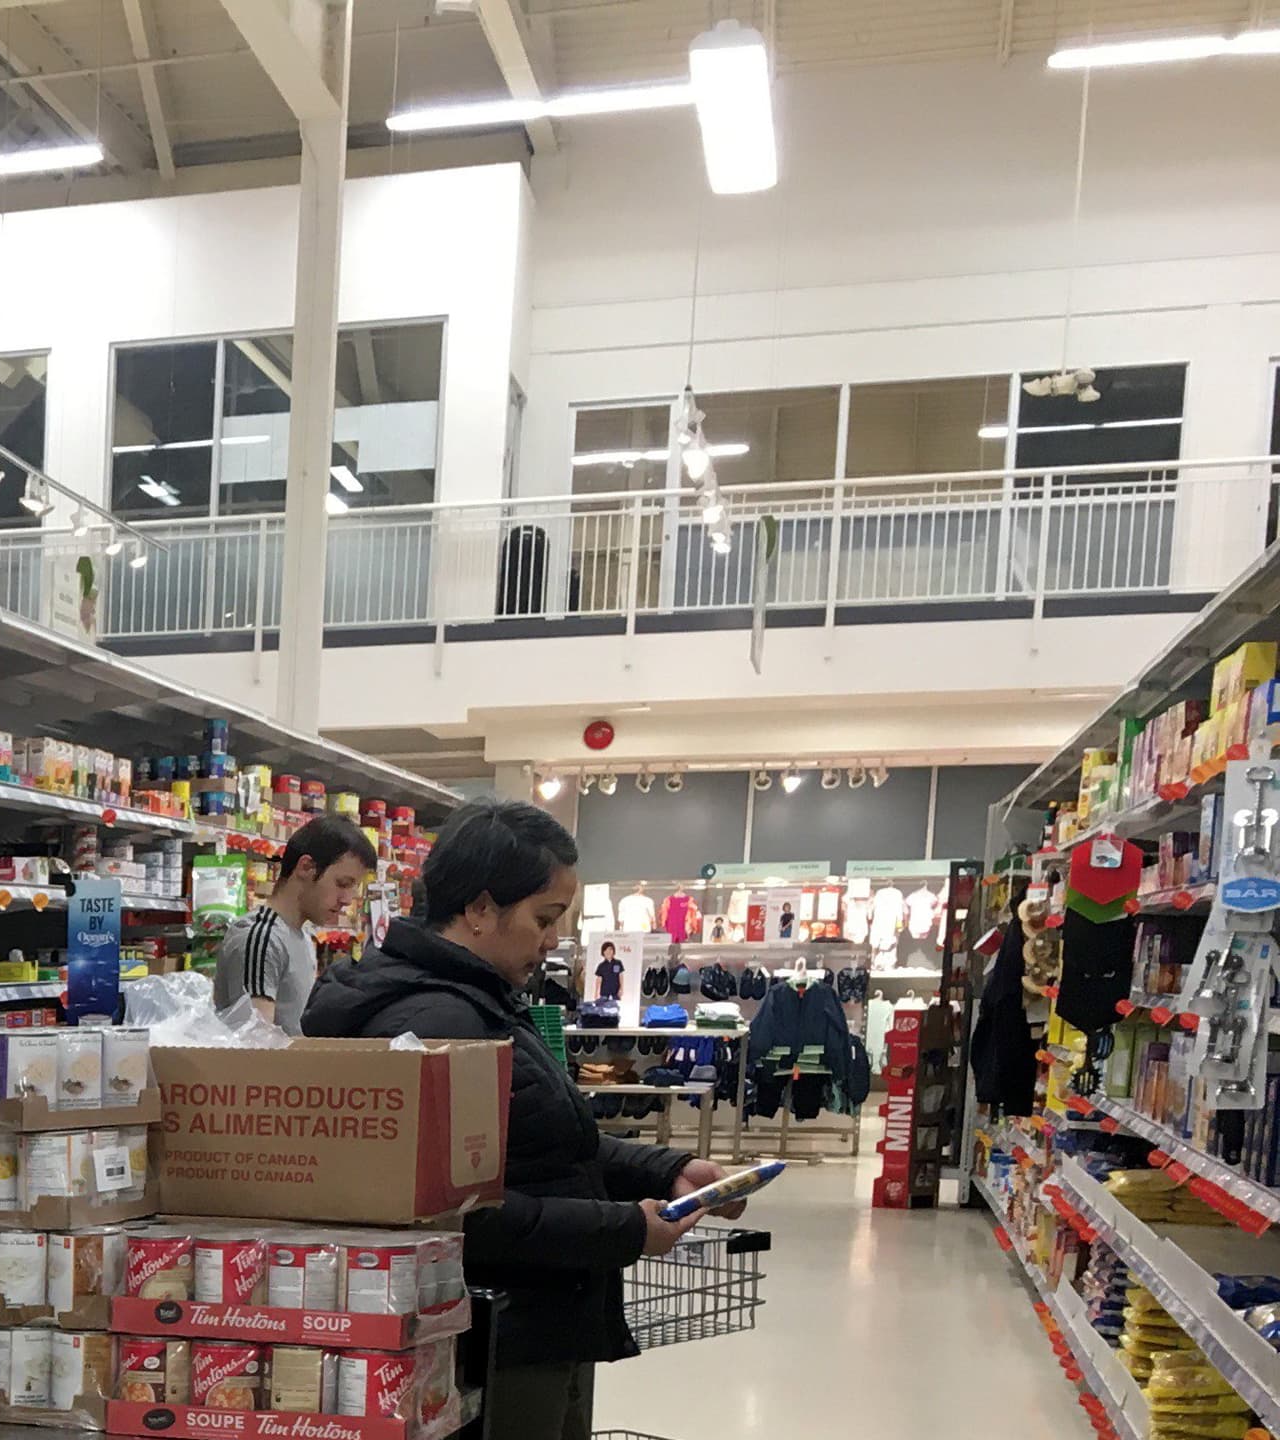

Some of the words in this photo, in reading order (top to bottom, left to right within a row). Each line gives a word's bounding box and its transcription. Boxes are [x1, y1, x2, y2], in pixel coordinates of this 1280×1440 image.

[80, 897, 114, 913] TASTE
[89, 915, 104, 931] BY
[158, 1083, 236, 1107] ARONI
[245, 1085, 405, 1112] PRODUCTS
[188, 1112, 399, 1141] ALIMENTAIRES
[885, 1088, 914, 1152] MINI.
[165, 1150, 231, 1164] PRODUCT
[238, 1152, 254, 1165] OF
[258, 1153, 319, 1168] CANADA
[166, 1166, 227, 1180] PRODUIT
[231, 1169, 250, 1181] DU
[254, 1169, 315, 1184] CANADA
[190, 1305, 219, 1327] Tim
[222, 1307, 287, 1332] Hortons
[302, 1315, 352, 1332] SOUP
[193, 1352, 214, 1374] Tim
[374, 1363, 404, 1386] Tim
[186, 1412, 245, 1430] SOUPE
[256, 1414, 289, 1437] Tim
[291, 1415, 362, 1440] Hortons
